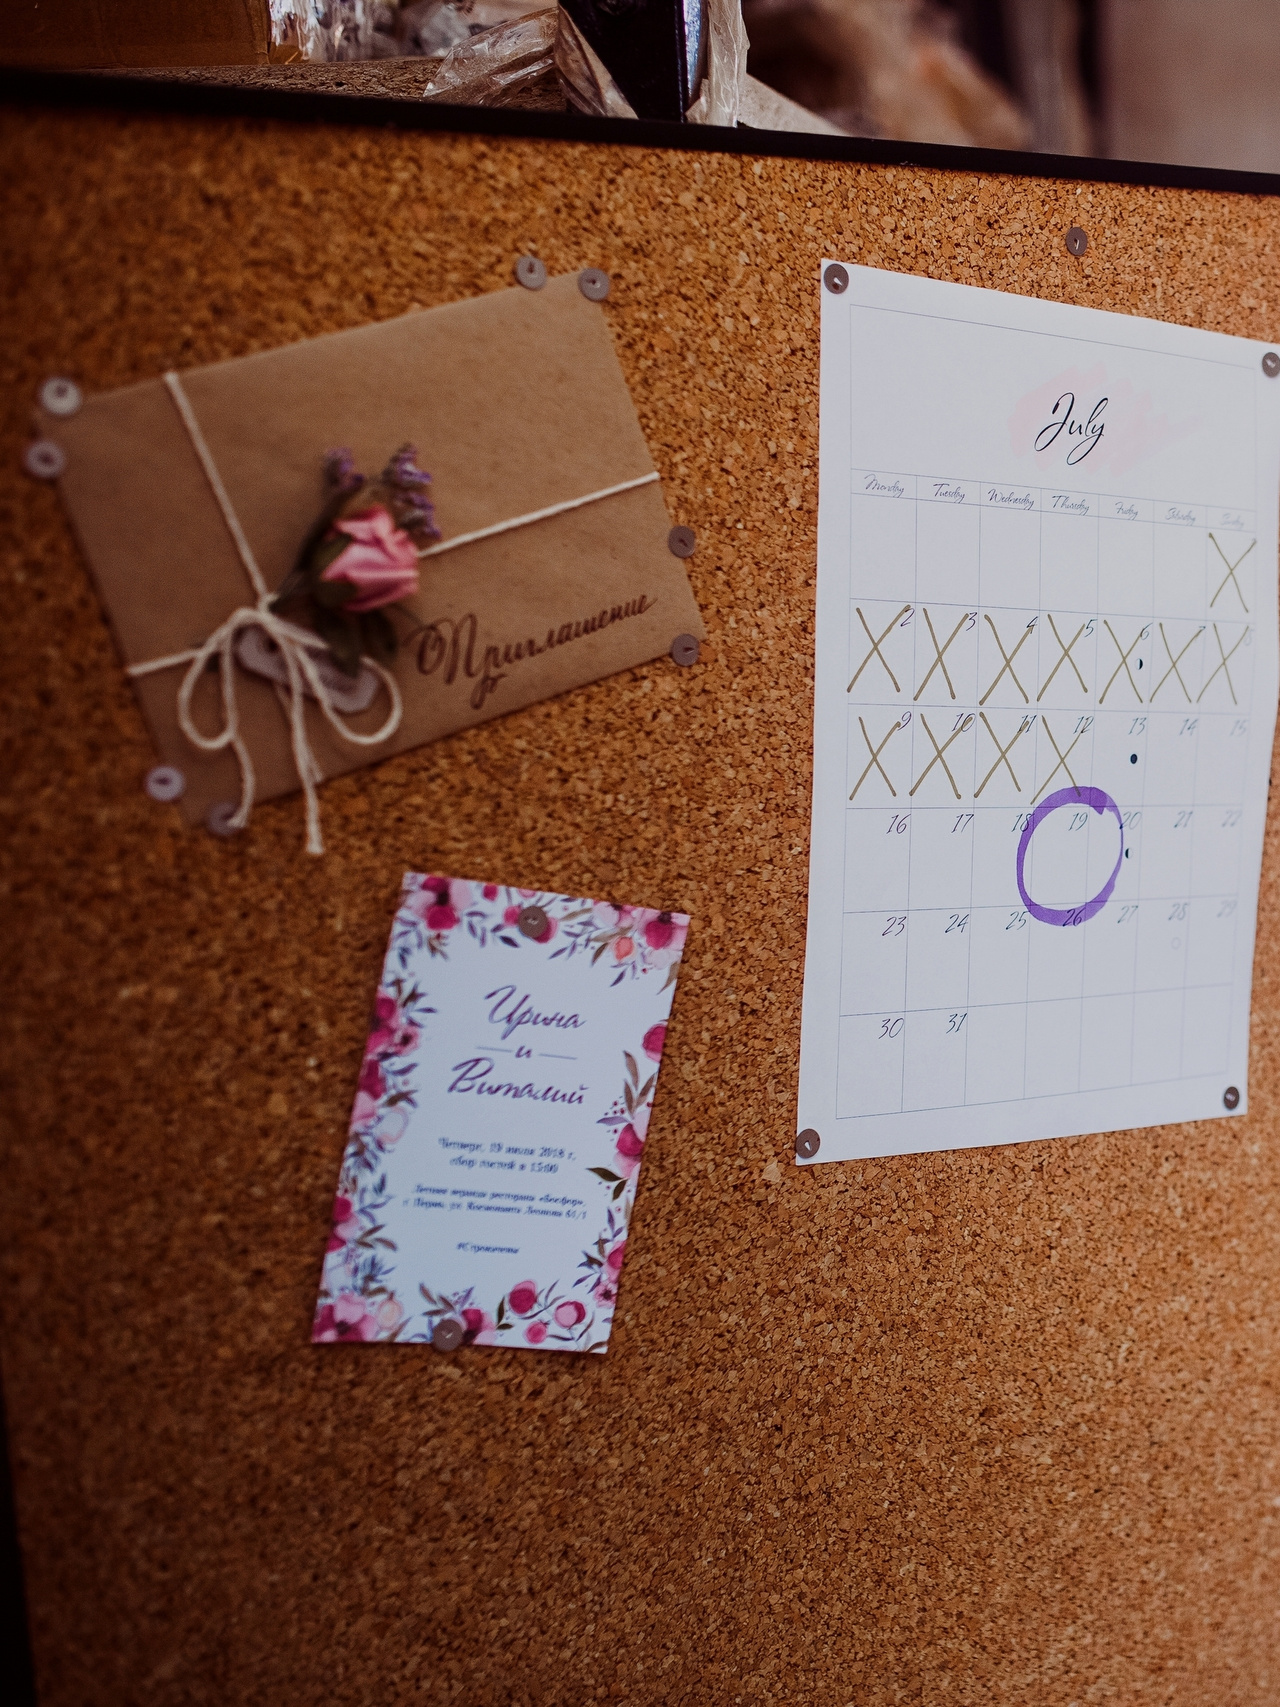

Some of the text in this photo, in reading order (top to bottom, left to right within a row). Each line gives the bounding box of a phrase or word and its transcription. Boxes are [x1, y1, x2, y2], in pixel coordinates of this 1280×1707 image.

[1034, 392, 1108, 465] July
[864, 474, 905, 497] Monday
[933, 483, 967, 502] Tuesday
[987, 488, 1035, 510] Wednesday
[1052, 495, 1090, 516] Thursday
[1114, 501, 1139, 520] Friday
[899, 609, 915, 627] 2
[965, 612, 979, 631] 3
[1085, 618, 1098, 637] 5
[1139, 621, 1154, 641] 6
[402, 594, 658, 710] Приглашение
[897, 711, 912, 731] 9
[951, 712, 976, 733] 10
[1017, 714, 1037, 733] 11
[1073, 715, 1095, 734] 12
[1127, 717, 1147, 736] 13
[1178, 718, 1198, 737] 14
[886, 814, 910, 836] 16
[951, 813, 974, 834] 17
[1011, 812, 1033, 833] 18
[1068, 812, 1088, 832] 19
[1119, 811, 1142, 830] 20
[1173, 810, 1193, 829] 21
[881, 915, 907, 937] 23
[944, 912, 969, 934] 24
[1005, 910, 1029, 931] 25
[1062, 907, 1084, 928] 26
[1117, 905, 1139, 924] 27
[1168, 902, 1188, 922] 28
[483, 985, 588, 1040] Ирина
[877, 1012, 968, 1040] 30 31
[515, 1042, 533, 1060] и
[447, 1057, 590, 1105] Виталий
